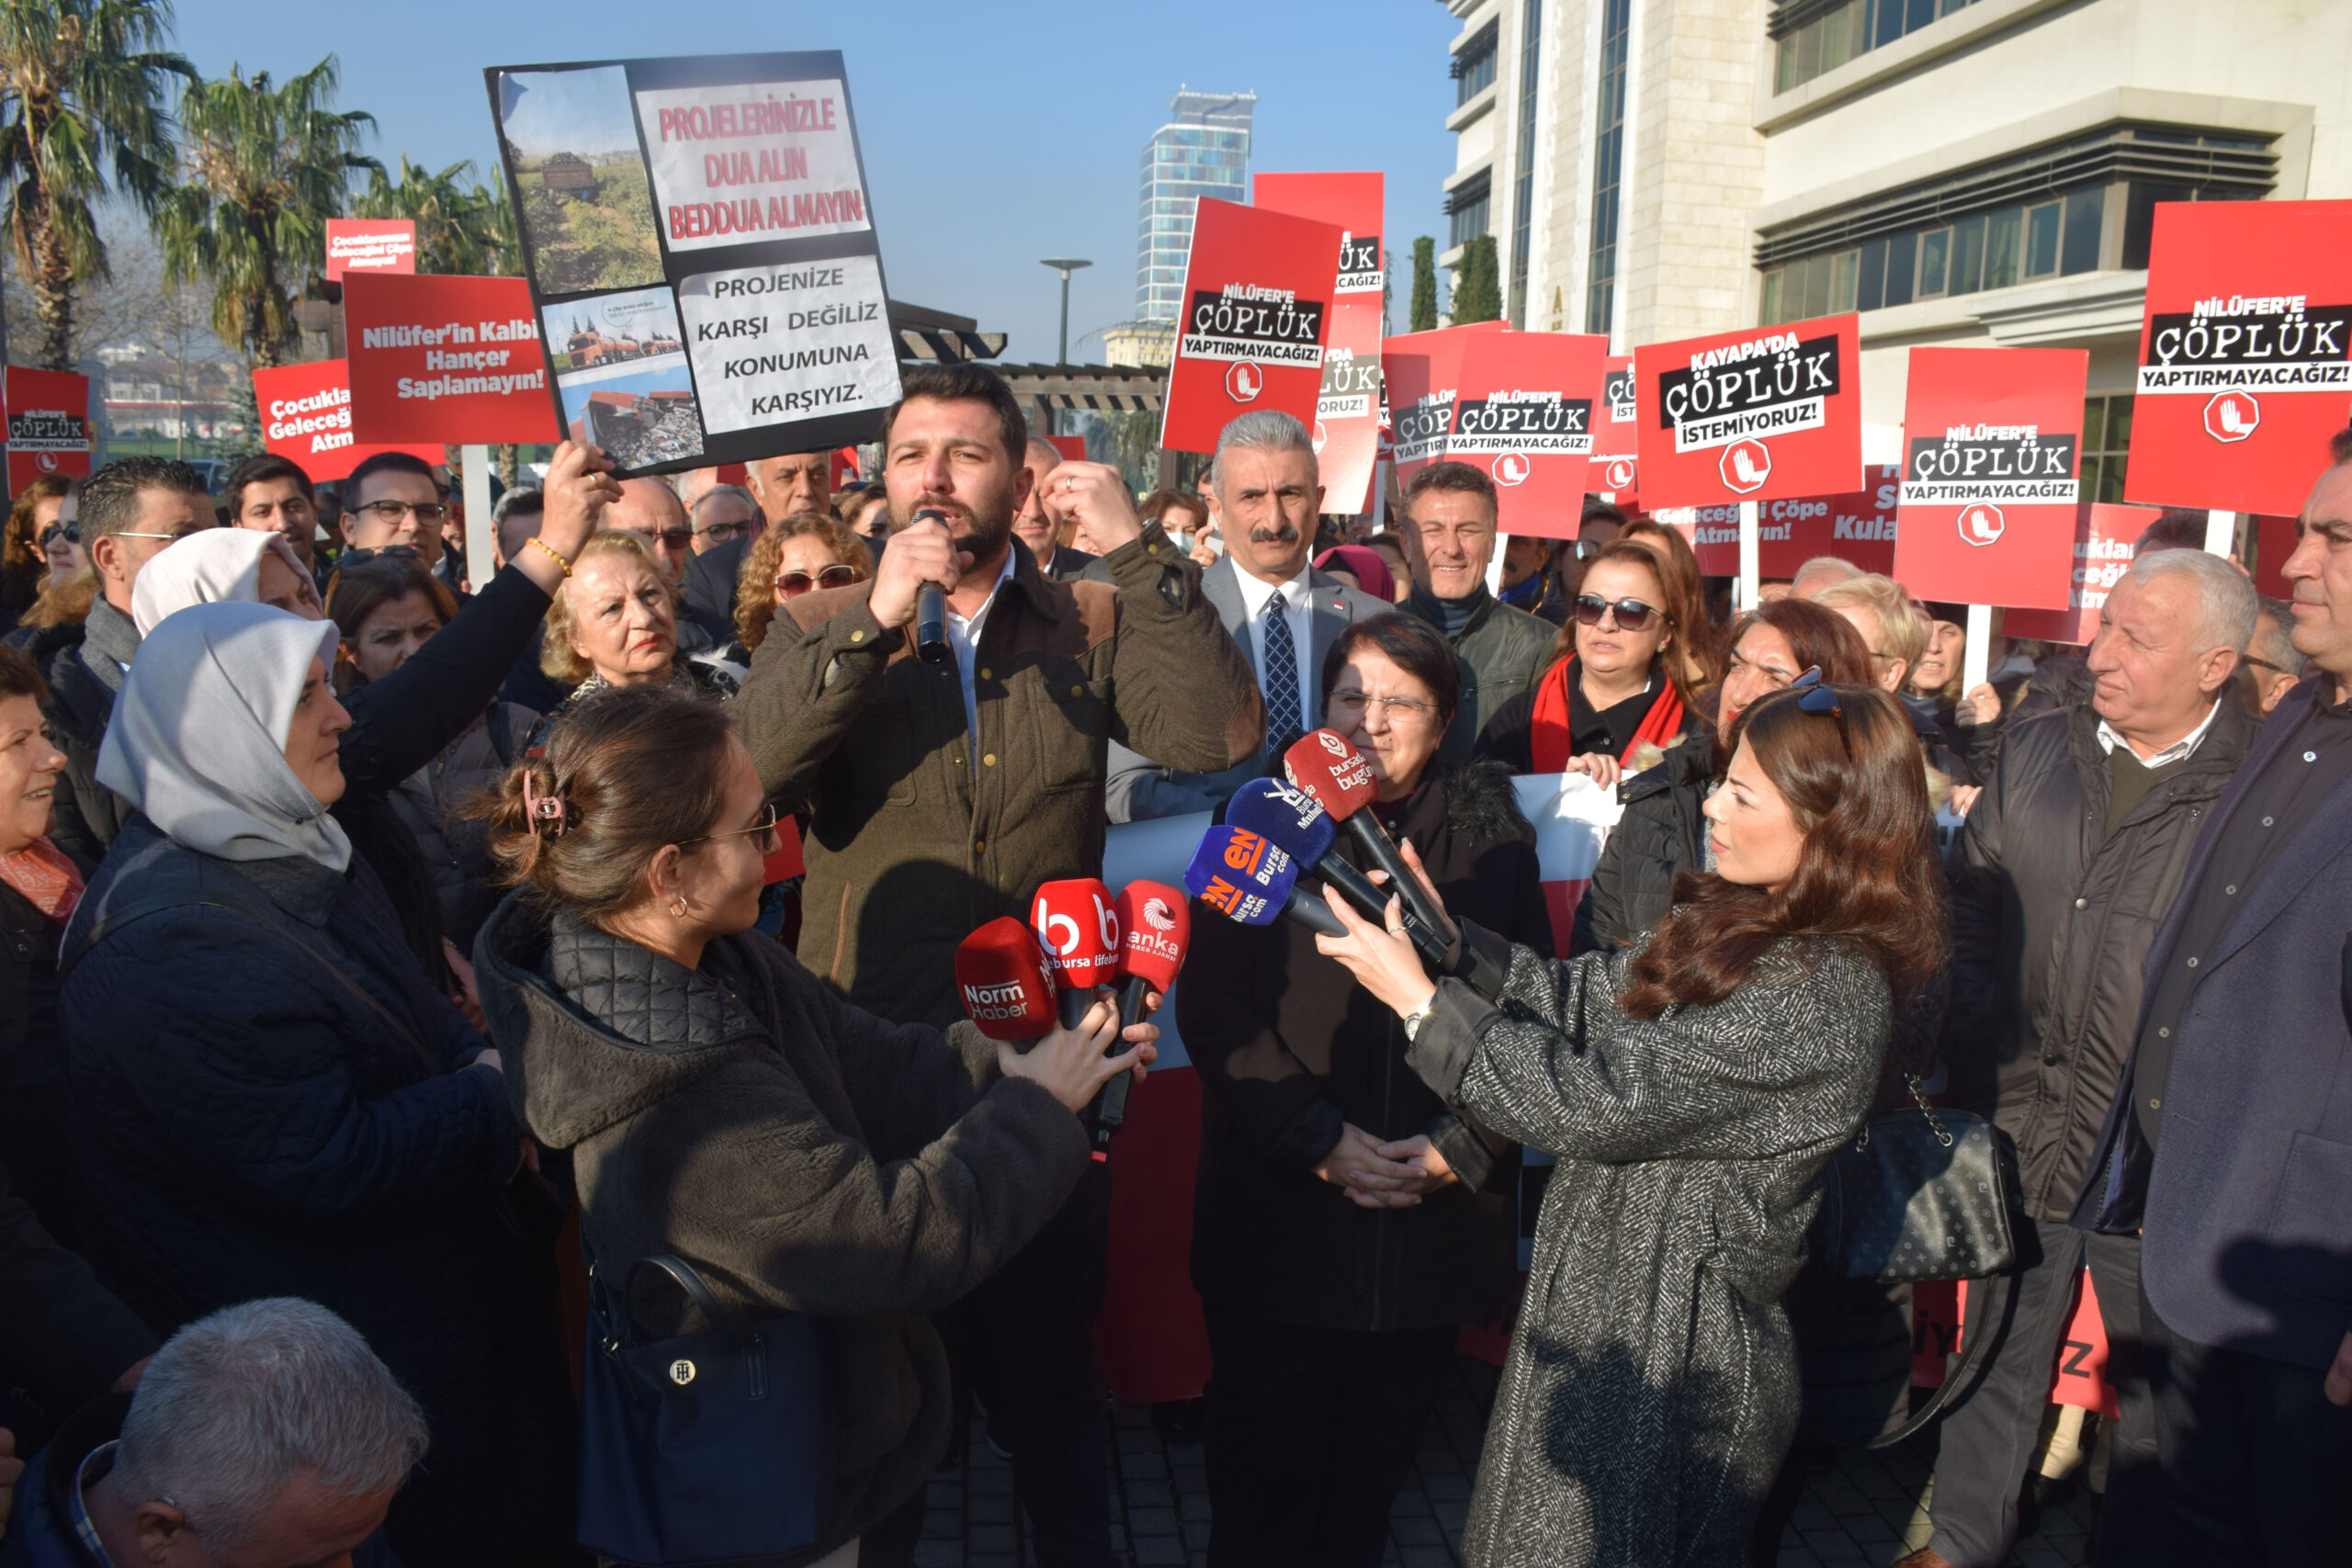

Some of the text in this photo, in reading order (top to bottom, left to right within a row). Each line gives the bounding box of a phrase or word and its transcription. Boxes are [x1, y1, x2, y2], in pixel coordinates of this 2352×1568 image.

[660, 93, 836, 142] PROJELERİNİZLE
[705, 147, 808, 187] DUA ALIN
[669, 189, 863, 239] BEDDUA ALMAYIN
[715, 266, 843, 299] PROJENİZE
[363, 319, 539, 349] Nilüfer'in Kalbi
[698, 300, 878, 342] KARŞI DEĞİLİZ
[1195, 299, 1317, 339] ÇÖPLÜK
[1185, 339, 1319, 361] YAPTIRMAYACAĞIZ!
[1690, 332, 1800, 372] KAYAPA'DA
[2155, 313, 2344, 367] ÇÖPLÜK
[426, 350, 510, 371] Hançer
[724, 344, 869, 378] KONUMUNA
[2143, 363, 2349, 387] YAPTIRMAYACAĞIZ!
[397, 368, 544, 400] Saplamayın!
[752, 383, 863, 415] KARŞIYIZ.
[1666, 350, 1833, 425] ÇÖPLÜK
[11, 418, 83, 439] ÇÖPLÜK
[1461, 403, 1586, 434] ÇÖPLÜK
[1682, 402, 1817, 444] İSTEMİYORUZ!
[1451, 434, 1589, 448] YAPTIRMAYACAĞIZ!
[1916, 440, 2068, 482] ÇÖPLÜK
[1905, 480, 2074, 499] YAPTIRMAYACAĞIZ!
[1771, 500, 1827, 522] Çöpe
[1127, 931, 1179, 957] anka
[965, 984, 1024, 1006] Norm
[970, 1000, 1028, 1021] Haber
